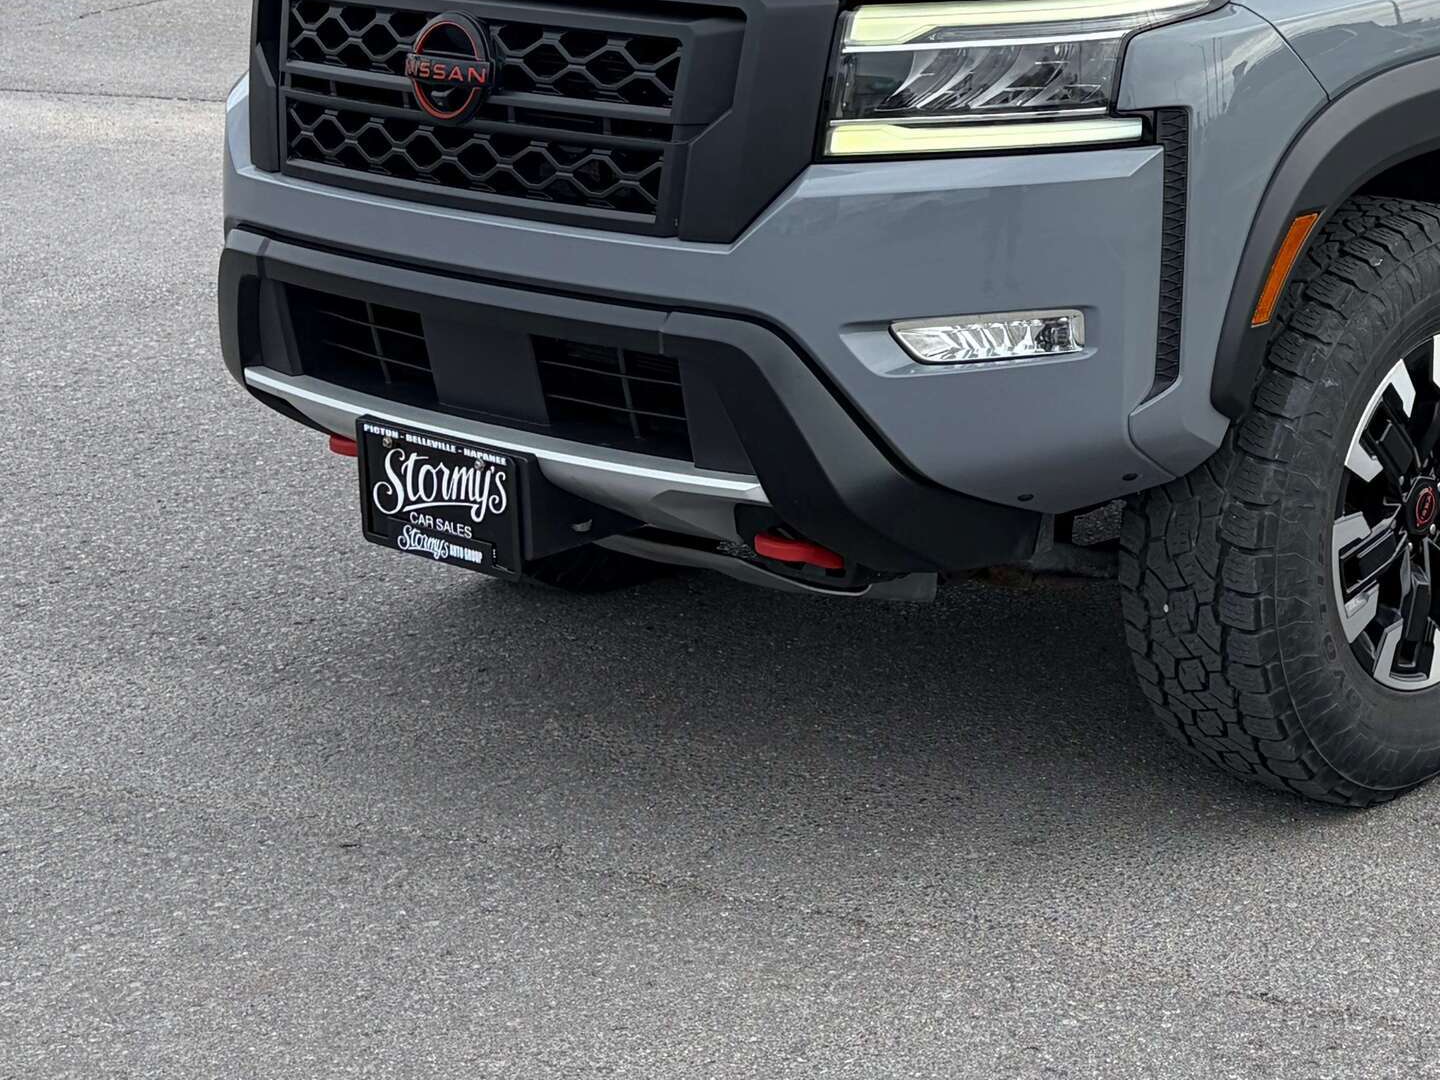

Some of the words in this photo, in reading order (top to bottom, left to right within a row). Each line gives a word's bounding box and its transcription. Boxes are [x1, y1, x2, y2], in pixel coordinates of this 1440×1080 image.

[405, 58, 486, 83] NISSAN
[363, 423, 399, 439] PICTON
[405, 433, 457, 453] BELLEVILLE
[373, 448, 507, 522] Stormy's
[409, 511, 434, 529] CAR
[435, 518, 473, 539] SALES
